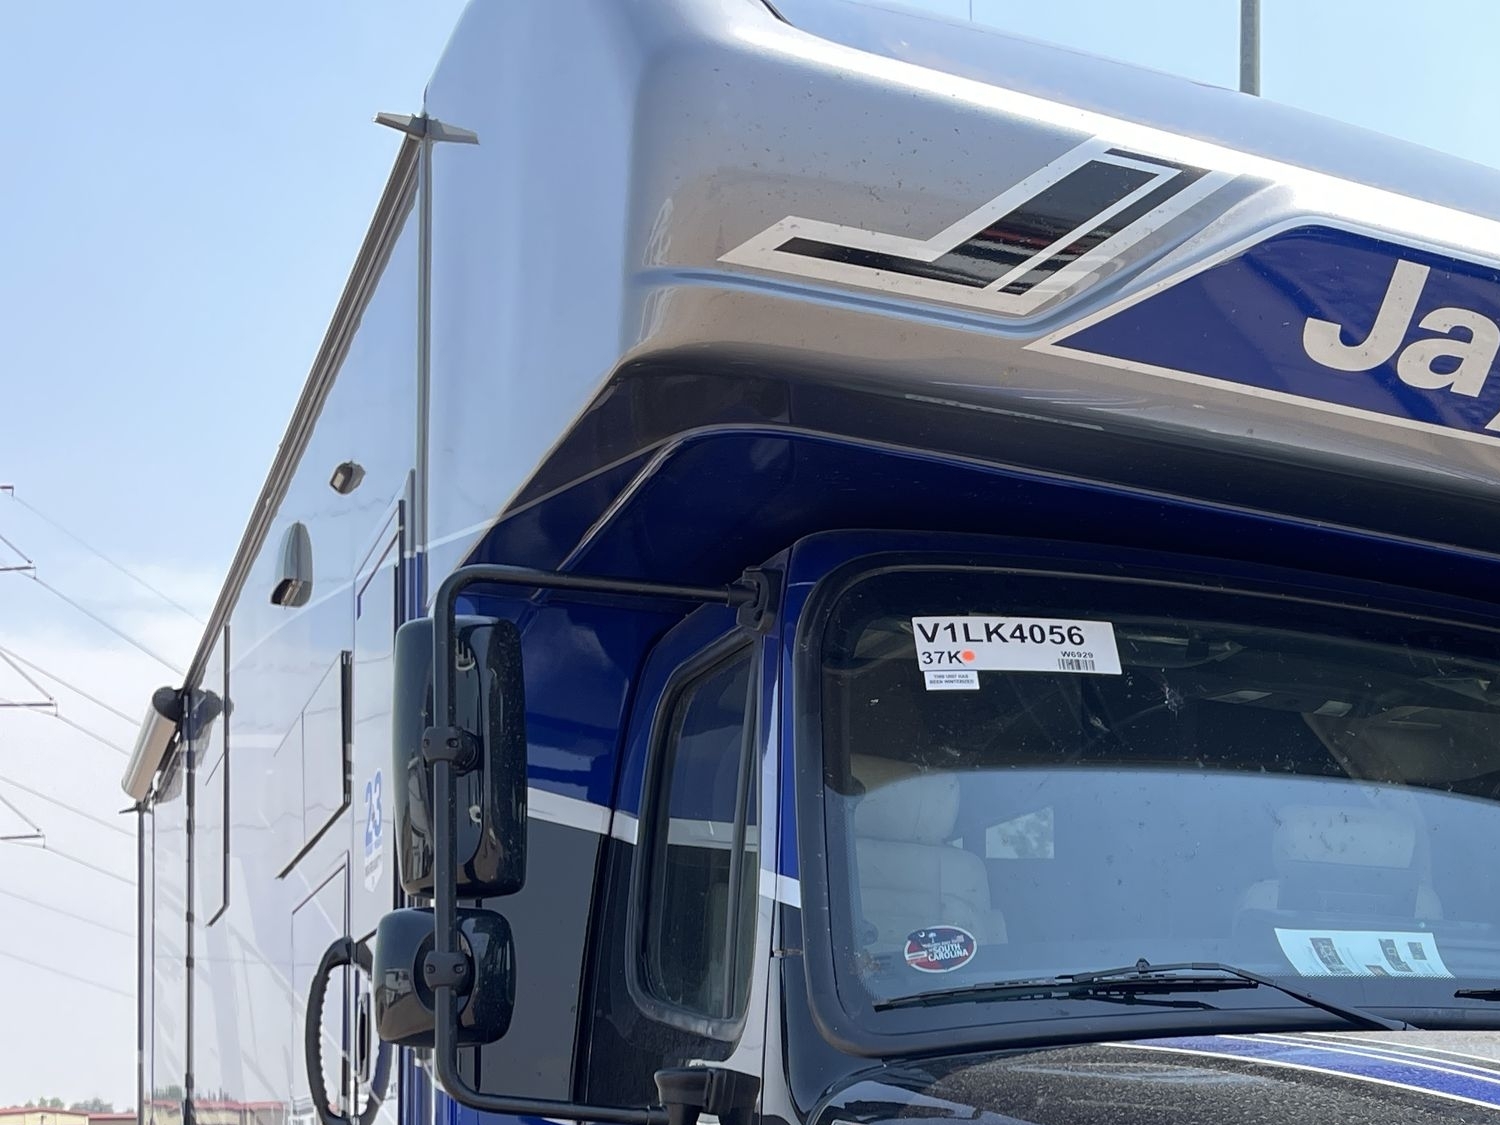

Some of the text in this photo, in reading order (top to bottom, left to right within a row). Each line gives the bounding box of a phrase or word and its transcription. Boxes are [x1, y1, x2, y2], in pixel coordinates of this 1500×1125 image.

[917, 623, 1084, 646] V1LK4056
[922, 651, 963, 665] 37K
[365, 771, 382, 847] 23
[928, 948, 969, 962] CAROLINA
[932, 943, 961, 953] SOUTH
